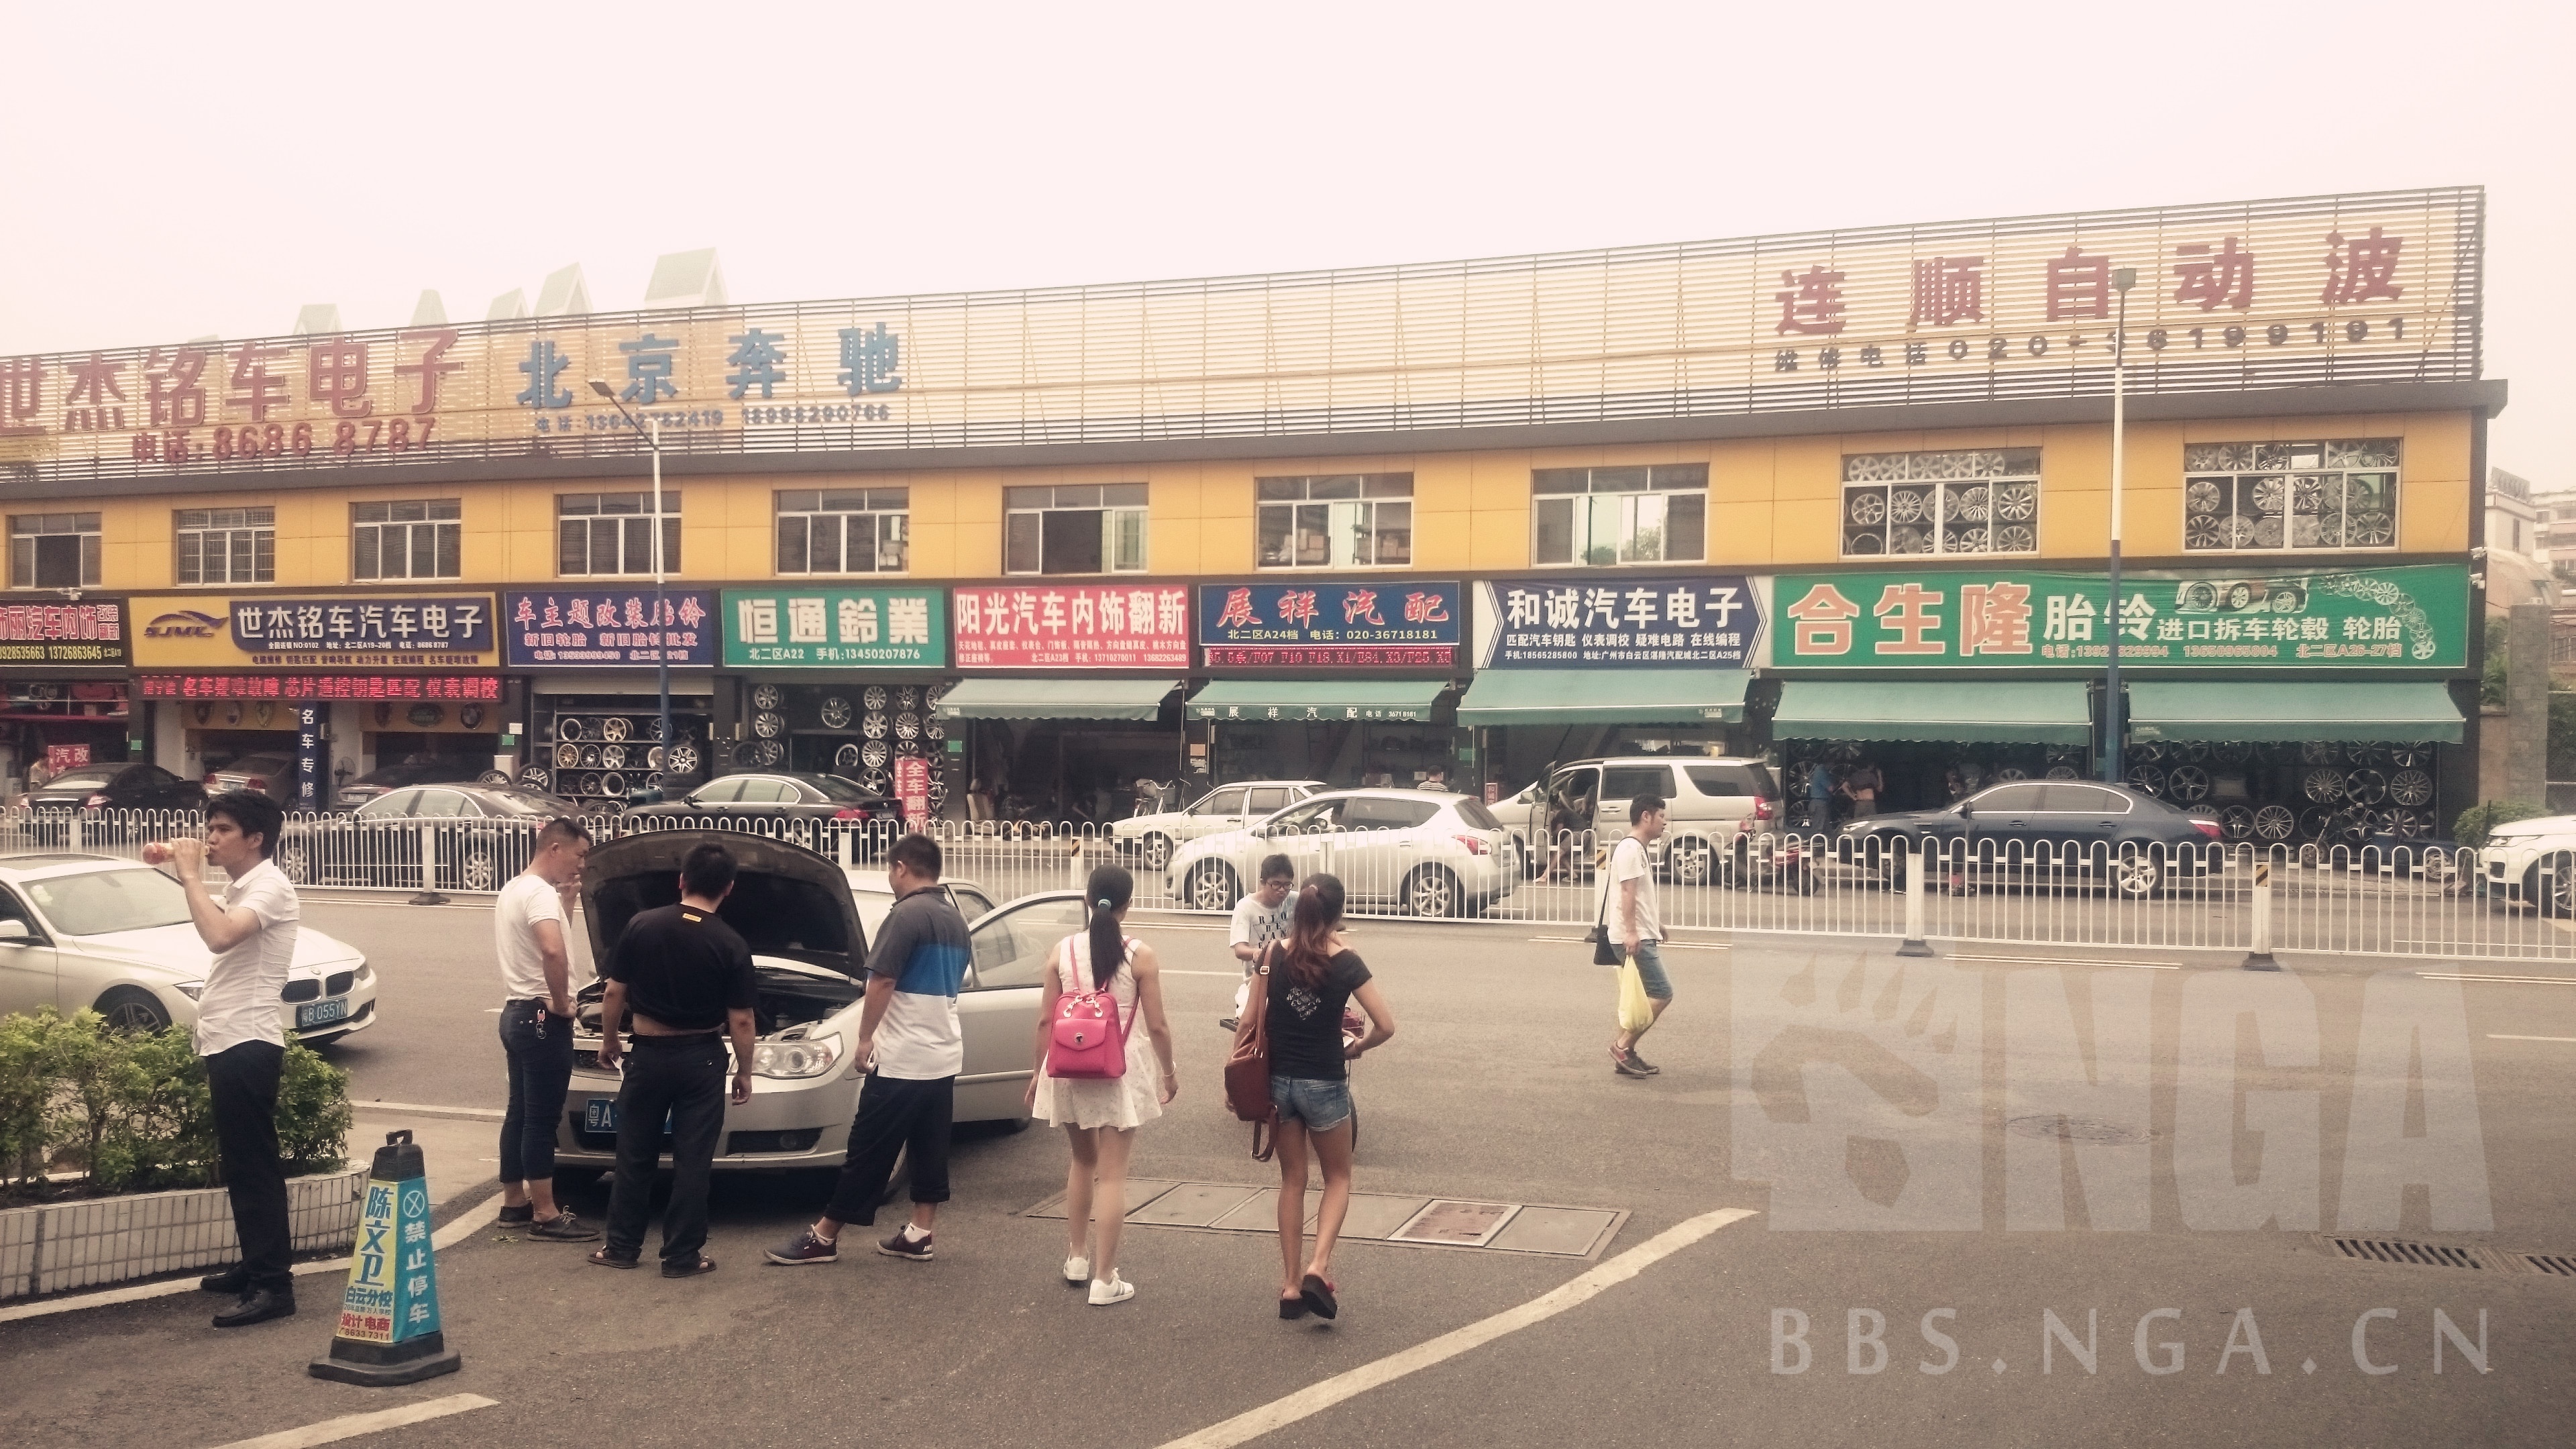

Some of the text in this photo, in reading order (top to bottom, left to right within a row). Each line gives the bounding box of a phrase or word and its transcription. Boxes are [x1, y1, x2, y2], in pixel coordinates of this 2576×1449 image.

[1775, 227, 2403, 335] 连顺自动波
[0, 329, 463, 435] 世杰铭车电子
[517, 322, 902, 409] 北京奔驰
[213, 422, 313, 460] 8686
[334, 416, 435, 456] 8787
[237, 604, 483, 639] 世杰铭车汽车电子
[957, 590, 1185, 635] 阳光汽车内饰翻新
[1217, 587, 1449, 629] 展祥汽配
[1507, 587, 1743, 629] 和诚汽车电子
[1787, 582, 2033, 657] 合生隆
[524, 633, 588, 647] 新旧轮胎
[1228, 629, 1298, 640] 北二区A24档
[1506, 633, 1741, 647] 匹配汽车钥匙 仪表调校 疑难电路 在线编程
[2156, 615, 2402, 641] 进口拆车轮毂 轮胎
[749, 648, 805, 661] 北二区A22
[301, 708, 315, 798] 名车专修
[1258, 911, 1287, 924] RIO
[1265, 922, 1281, 932] DE
[404, 1220, 430, 1324] 禁止停车
[345, 1285, 394, 1307] 白云分校
[341, 1312, 391, 1332] 设计 电商
